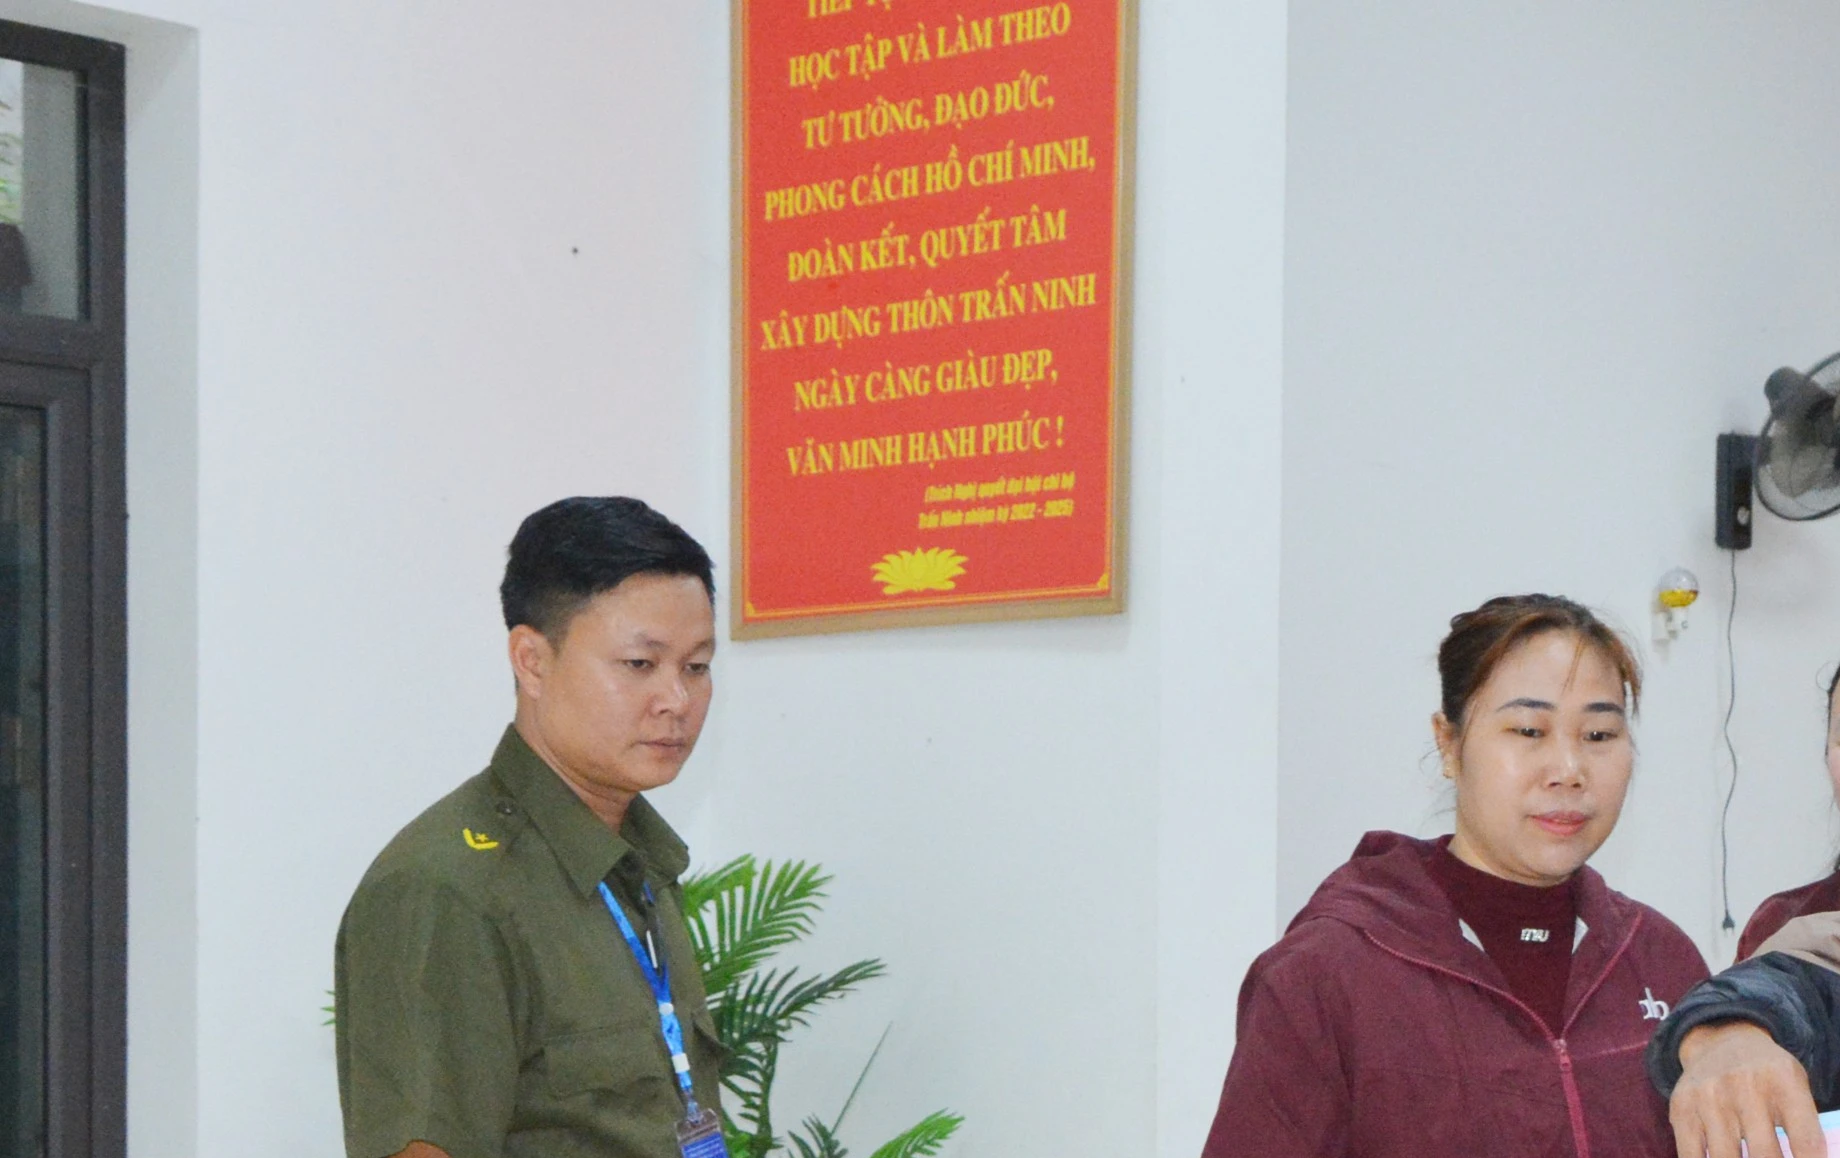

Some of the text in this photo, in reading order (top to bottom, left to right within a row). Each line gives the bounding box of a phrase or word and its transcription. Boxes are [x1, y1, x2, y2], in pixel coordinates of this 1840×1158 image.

[789, 3, 1071, 91] HỌC TẬP VÀ LÀM THEO
[803, 69, 1054, 148] TƯ TƯỞNG, ĐẠO ĐỨC,
[764, 136, 1095, 221] PHONG CÁCH HỒ CHÍ MINH,
[787, 203, 1067, 281] ĐOÀN KẾT, QUYẾT TÂM
[760, 271, 1096, 351] XÂY DỰNG THÔN TRẤN NINH
[794, 348, 1057, 412] NGÀY CÀNG GIÀU ĐẸP,
[787, 439, 834, 476] VĂN
[839, 435, 901, 469] MINH
[907, 428, 976, 469] HẠNH
[982, 411, 1051, 455] PHÚC
